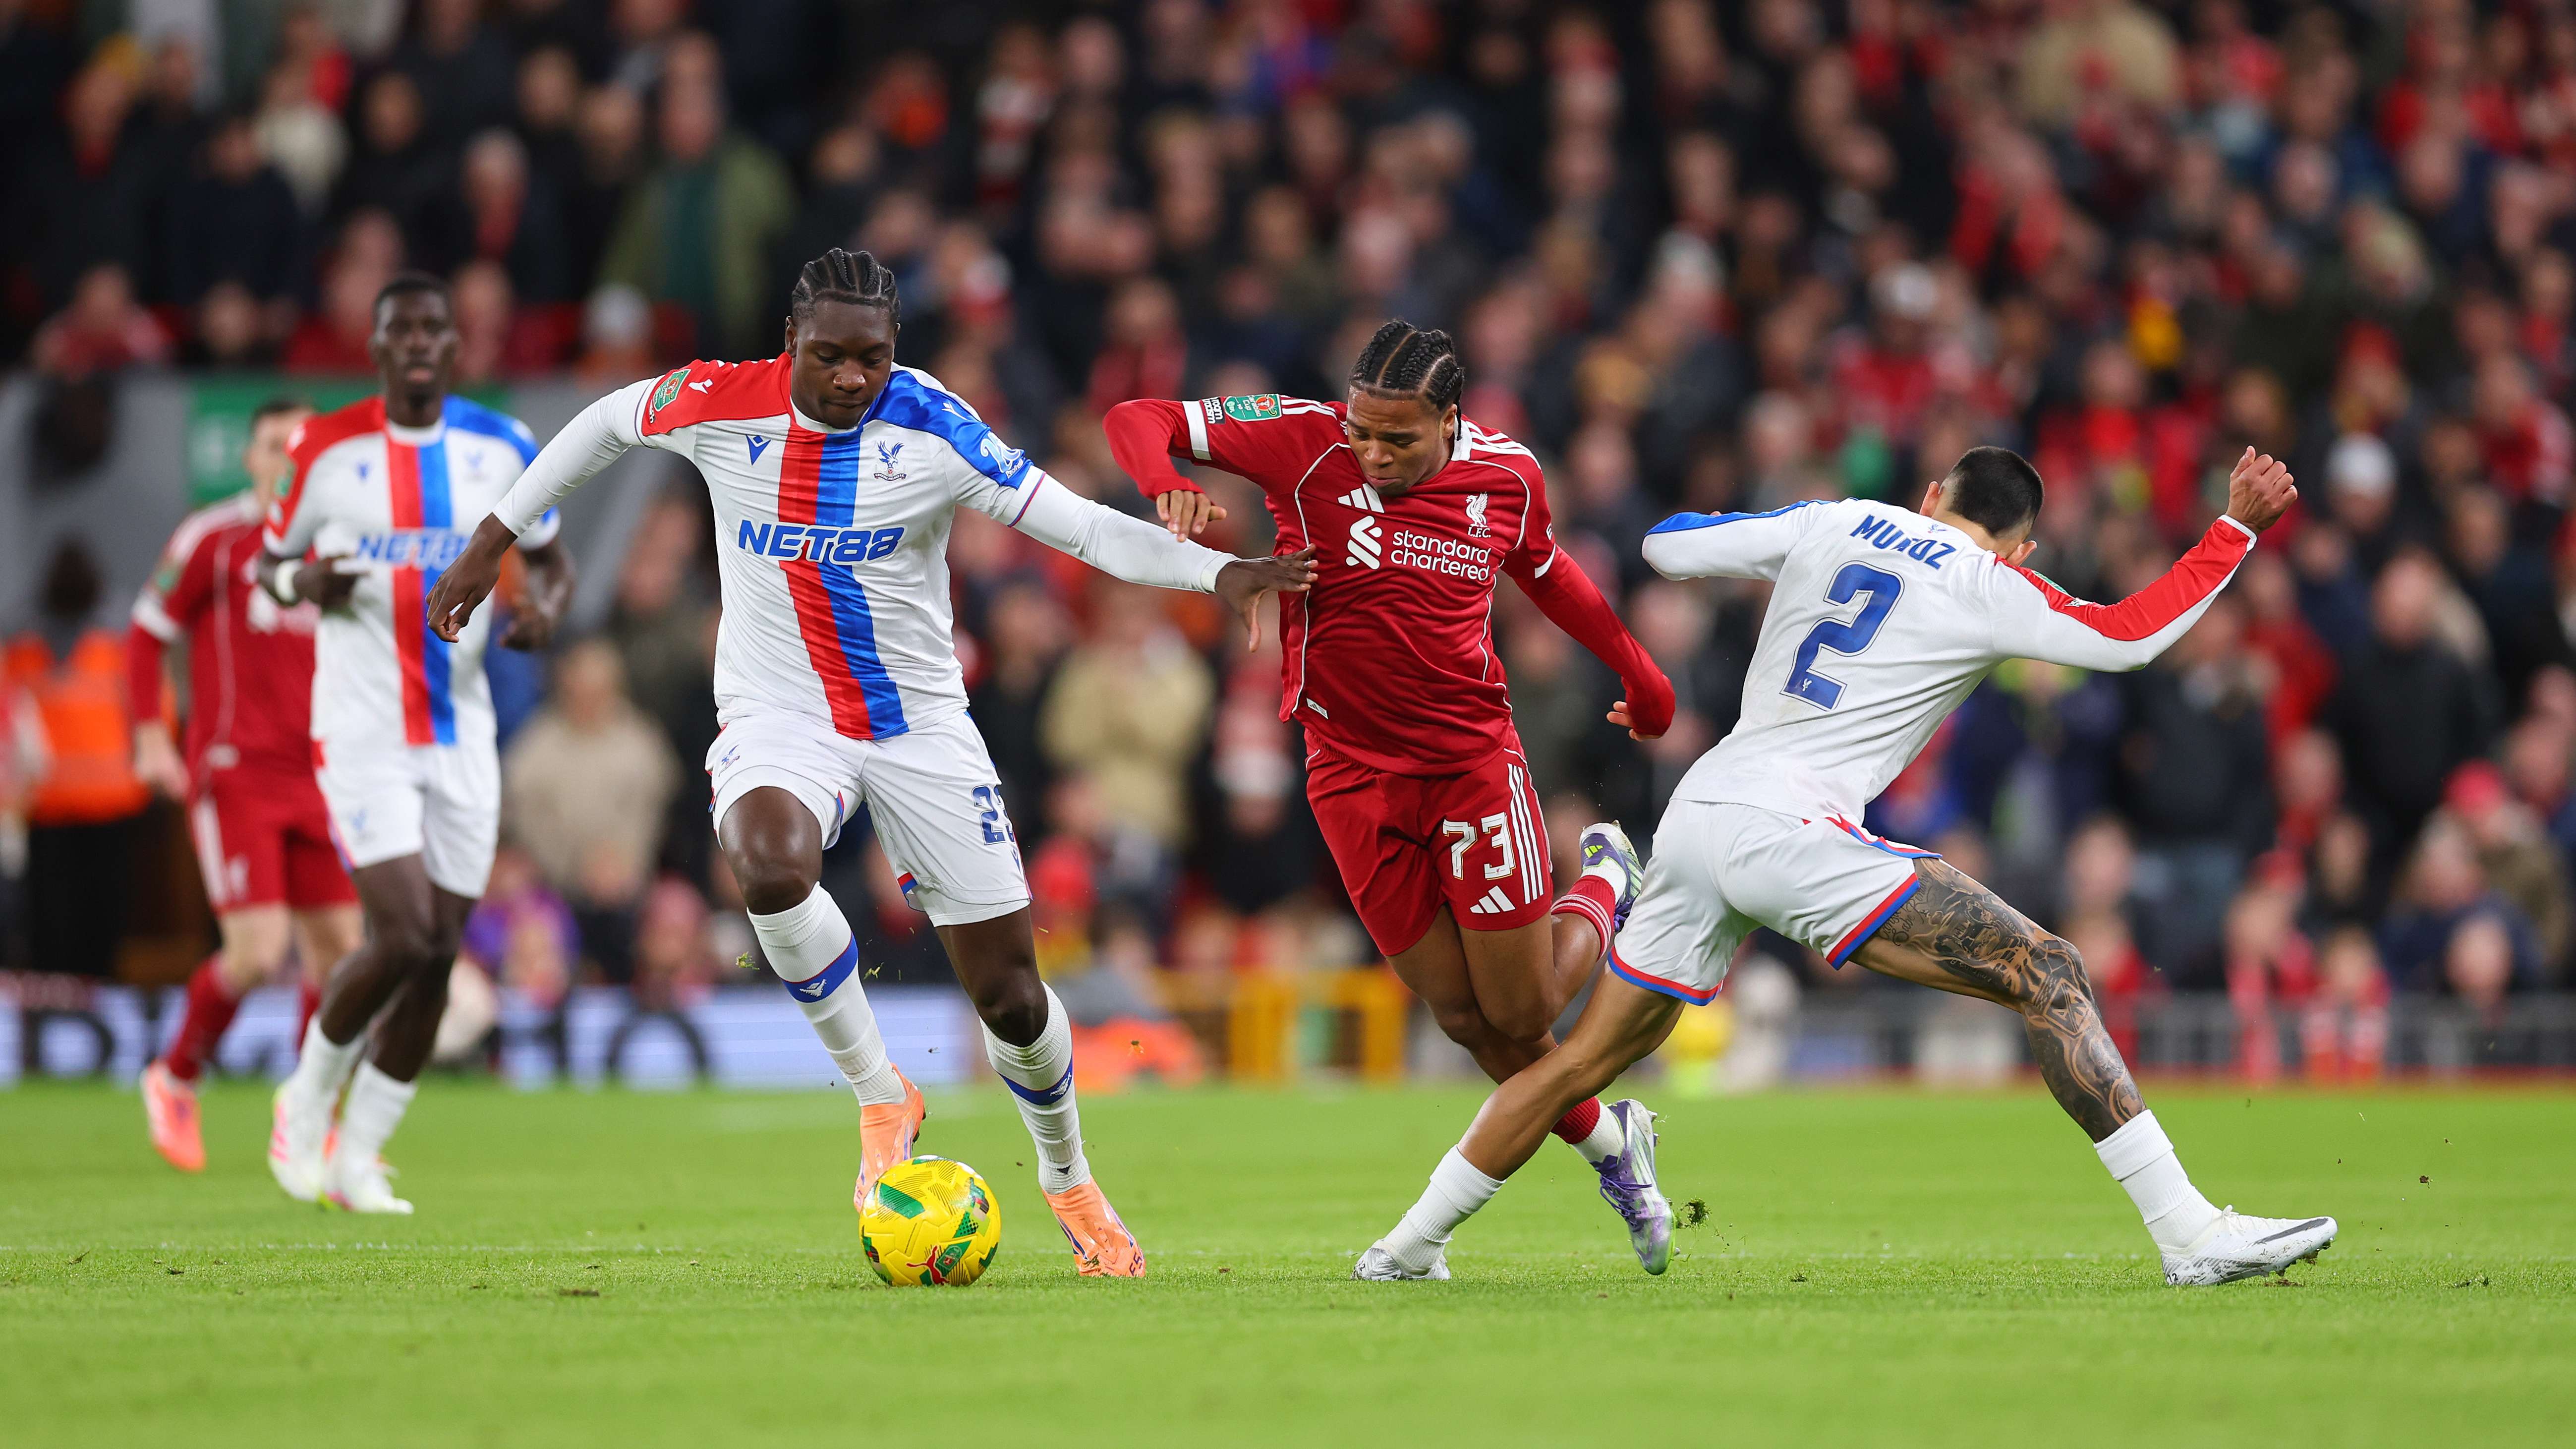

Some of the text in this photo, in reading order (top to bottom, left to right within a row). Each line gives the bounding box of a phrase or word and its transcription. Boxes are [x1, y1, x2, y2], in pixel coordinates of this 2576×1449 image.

[738, 519, 905, 563] NET88
[1392, 529, 1491, 564] standard
[1468, 526, 1491, 538] L.F.C.
[1390, 548, 1490, 581] chartered
[1779, 560, 1905, 712] 2
[1442, 811, 1516, 881] 73
